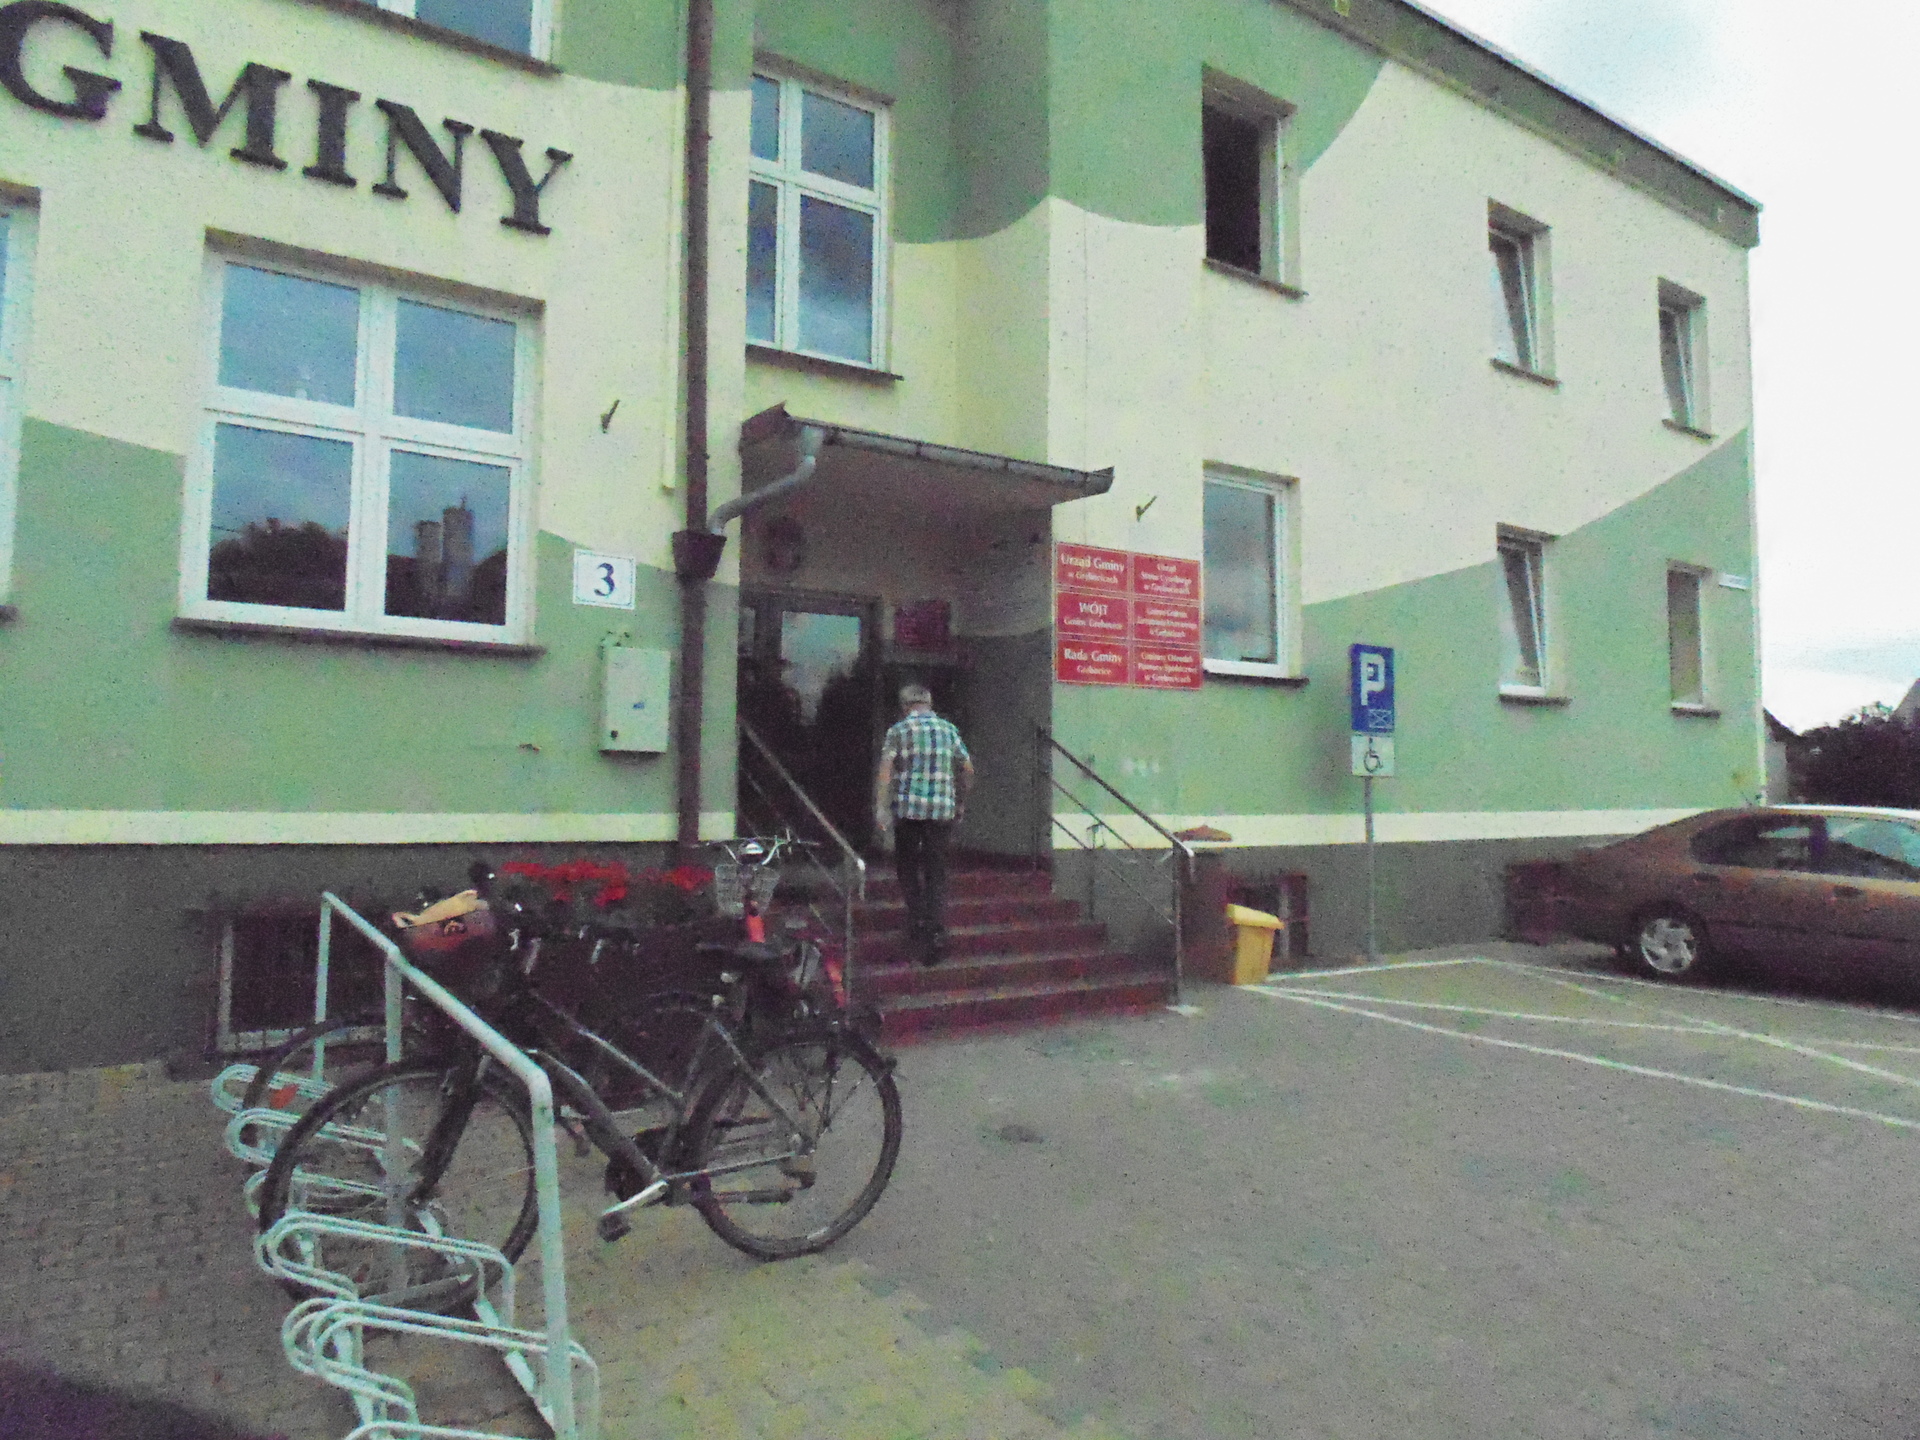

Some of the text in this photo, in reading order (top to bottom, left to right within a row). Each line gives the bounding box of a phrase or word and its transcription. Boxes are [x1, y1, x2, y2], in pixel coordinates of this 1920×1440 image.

[0, 0, 573, 235] GMINY
[594, 562, 615, 597] 3
[1093, 556, 1125, 573] Gminy
[1064, 648, 1122, 665] Rada Gminy
[1360, 652, 1386, 706] P
